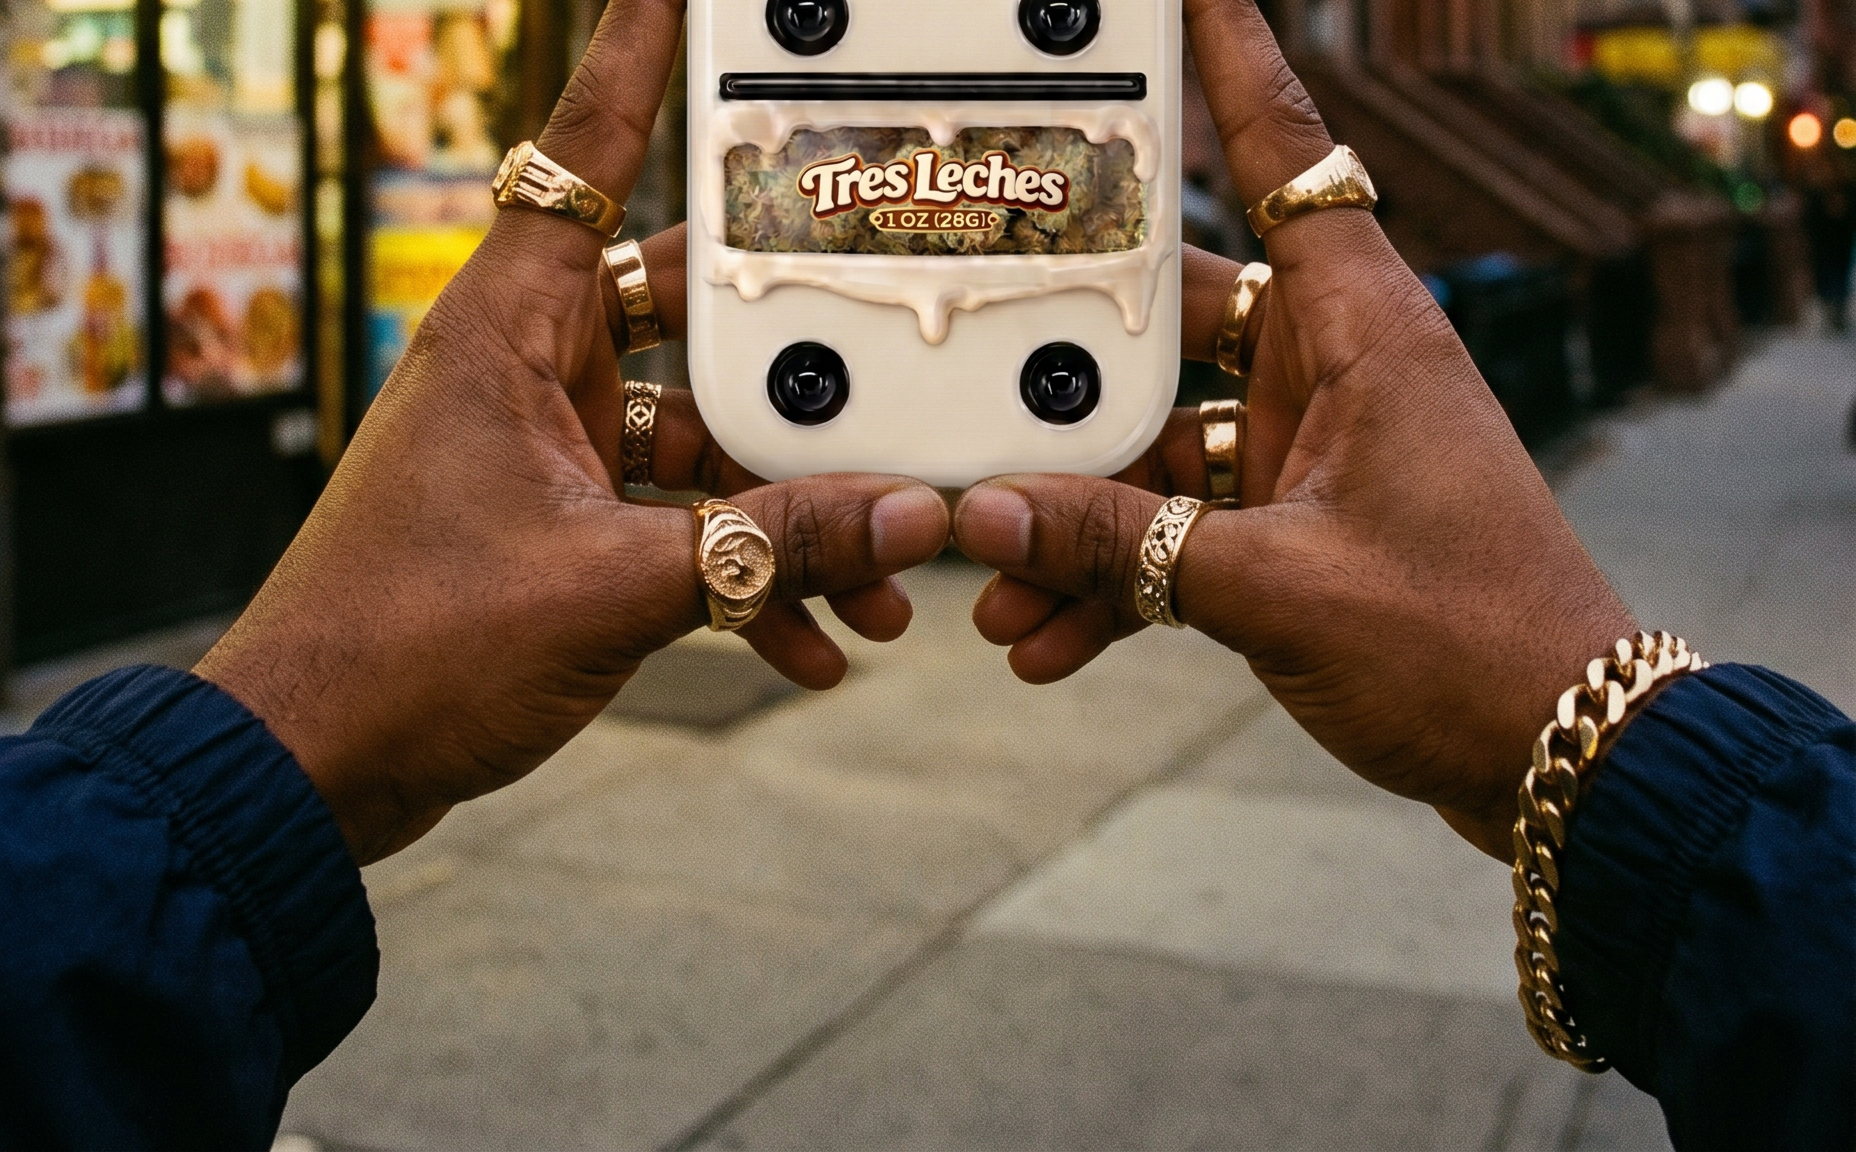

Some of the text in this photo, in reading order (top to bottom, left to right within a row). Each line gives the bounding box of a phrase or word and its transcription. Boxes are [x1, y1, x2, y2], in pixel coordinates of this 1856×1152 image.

[798, 150, 1069, 217] Tres Leches
[886, 212, 987, 229] 1 OZ (28G)
